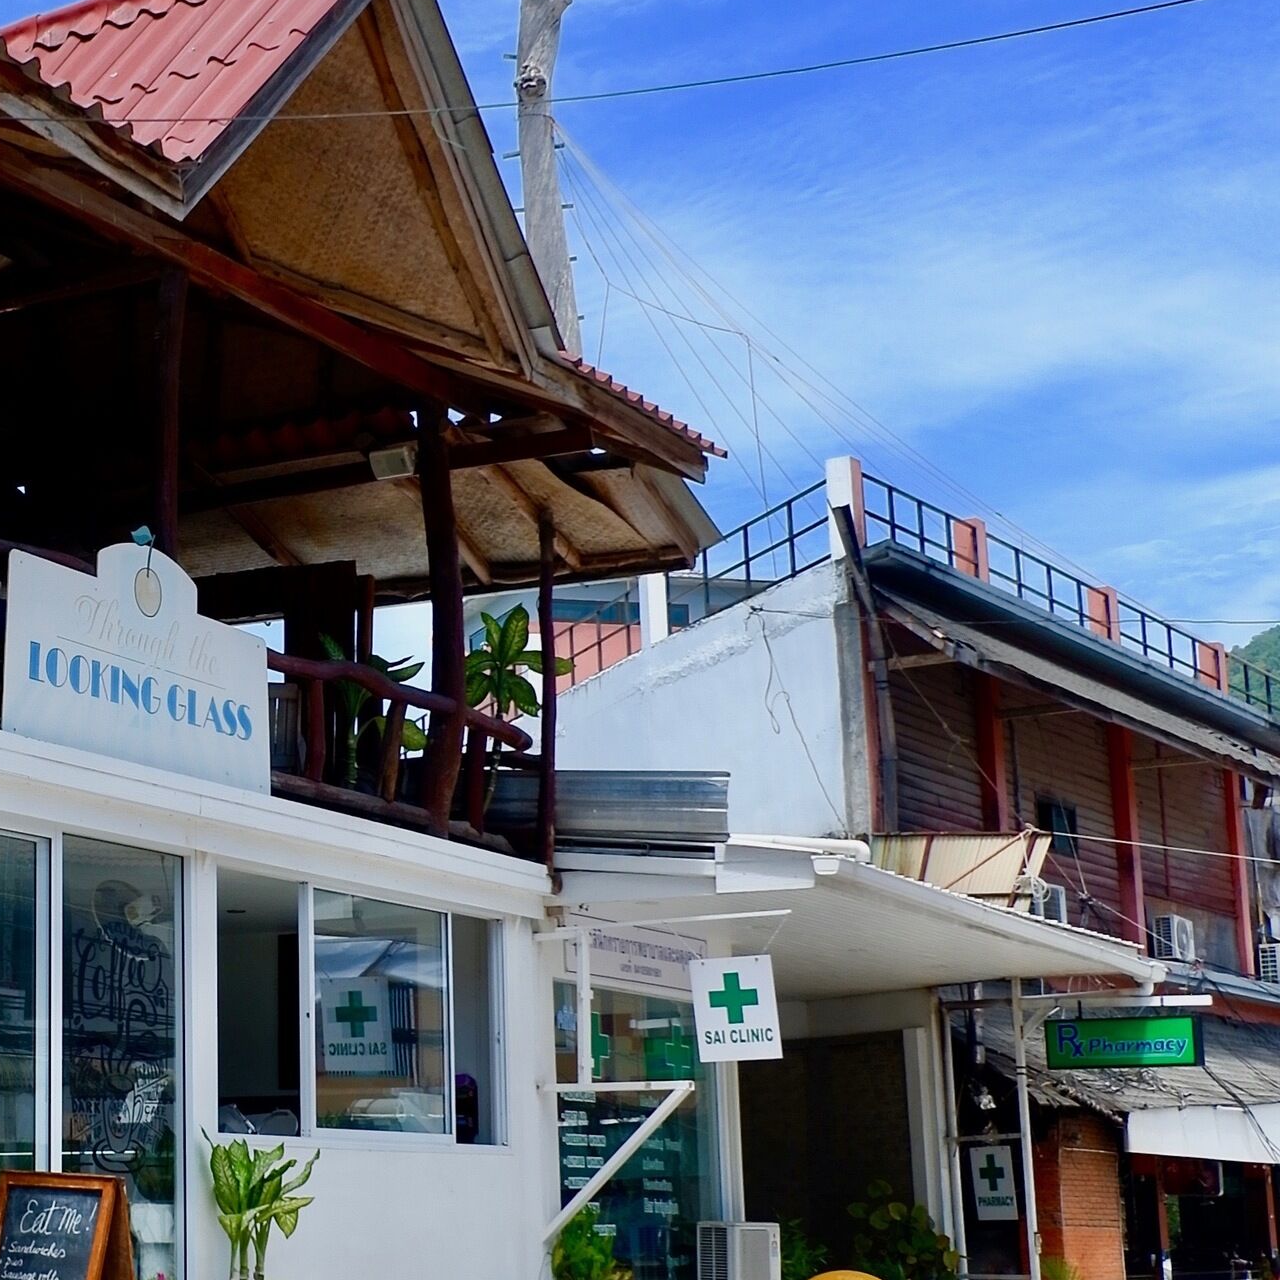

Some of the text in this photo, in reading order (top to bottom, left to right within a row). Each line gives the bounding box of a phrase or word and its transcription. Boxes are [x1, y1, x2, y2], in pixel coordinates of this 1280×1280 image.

[74, 594, 218, 674] Through the
[28, 640, 253, 741] LOOKING GLASS
[704, 1027, 774, 1046] SAI CLINIC
[1088, 1038, 1189, 1058] Pharmacy
[20, 1199, 60, 1236] Eat
[8, 1240, 66, 1259] Sandwiches
